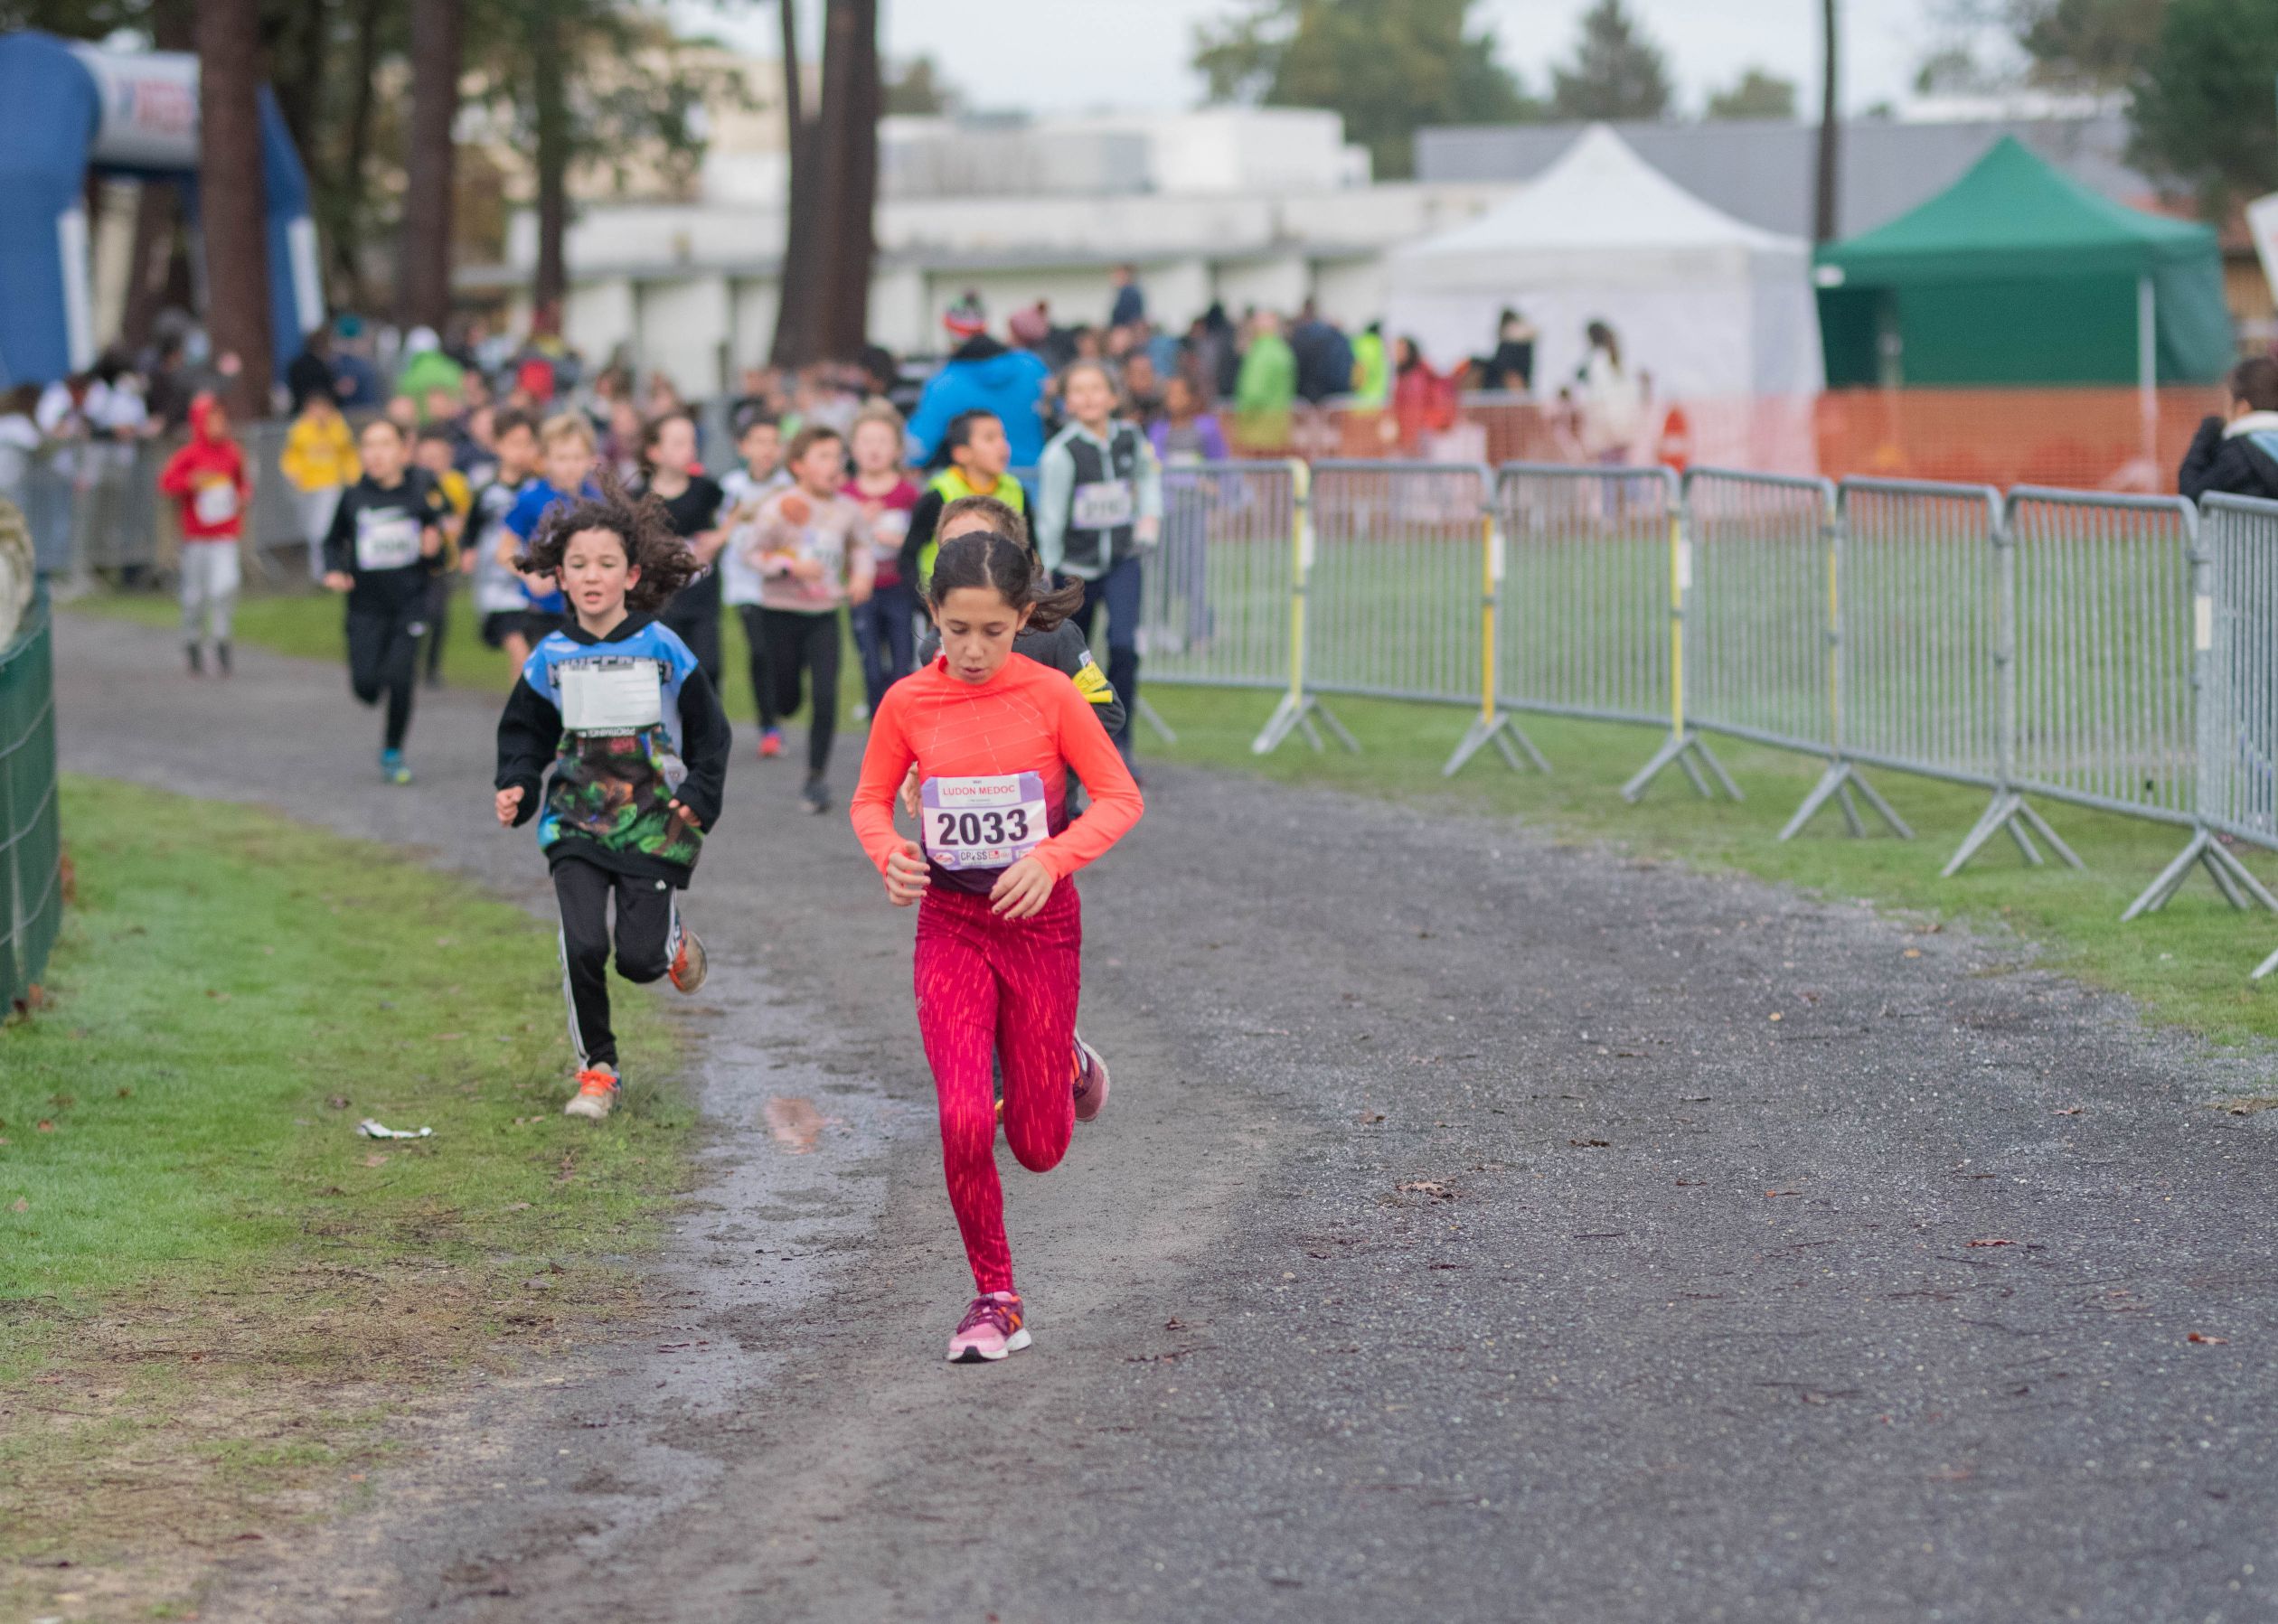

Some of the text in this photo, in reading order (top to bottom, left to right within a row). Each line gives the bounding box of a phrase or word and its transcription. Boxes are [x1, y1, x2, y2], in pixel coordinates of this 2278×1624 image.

[943, 784, 1015, 796] LUDON MEDOC
[937, 808, 1029, 846] 2033
